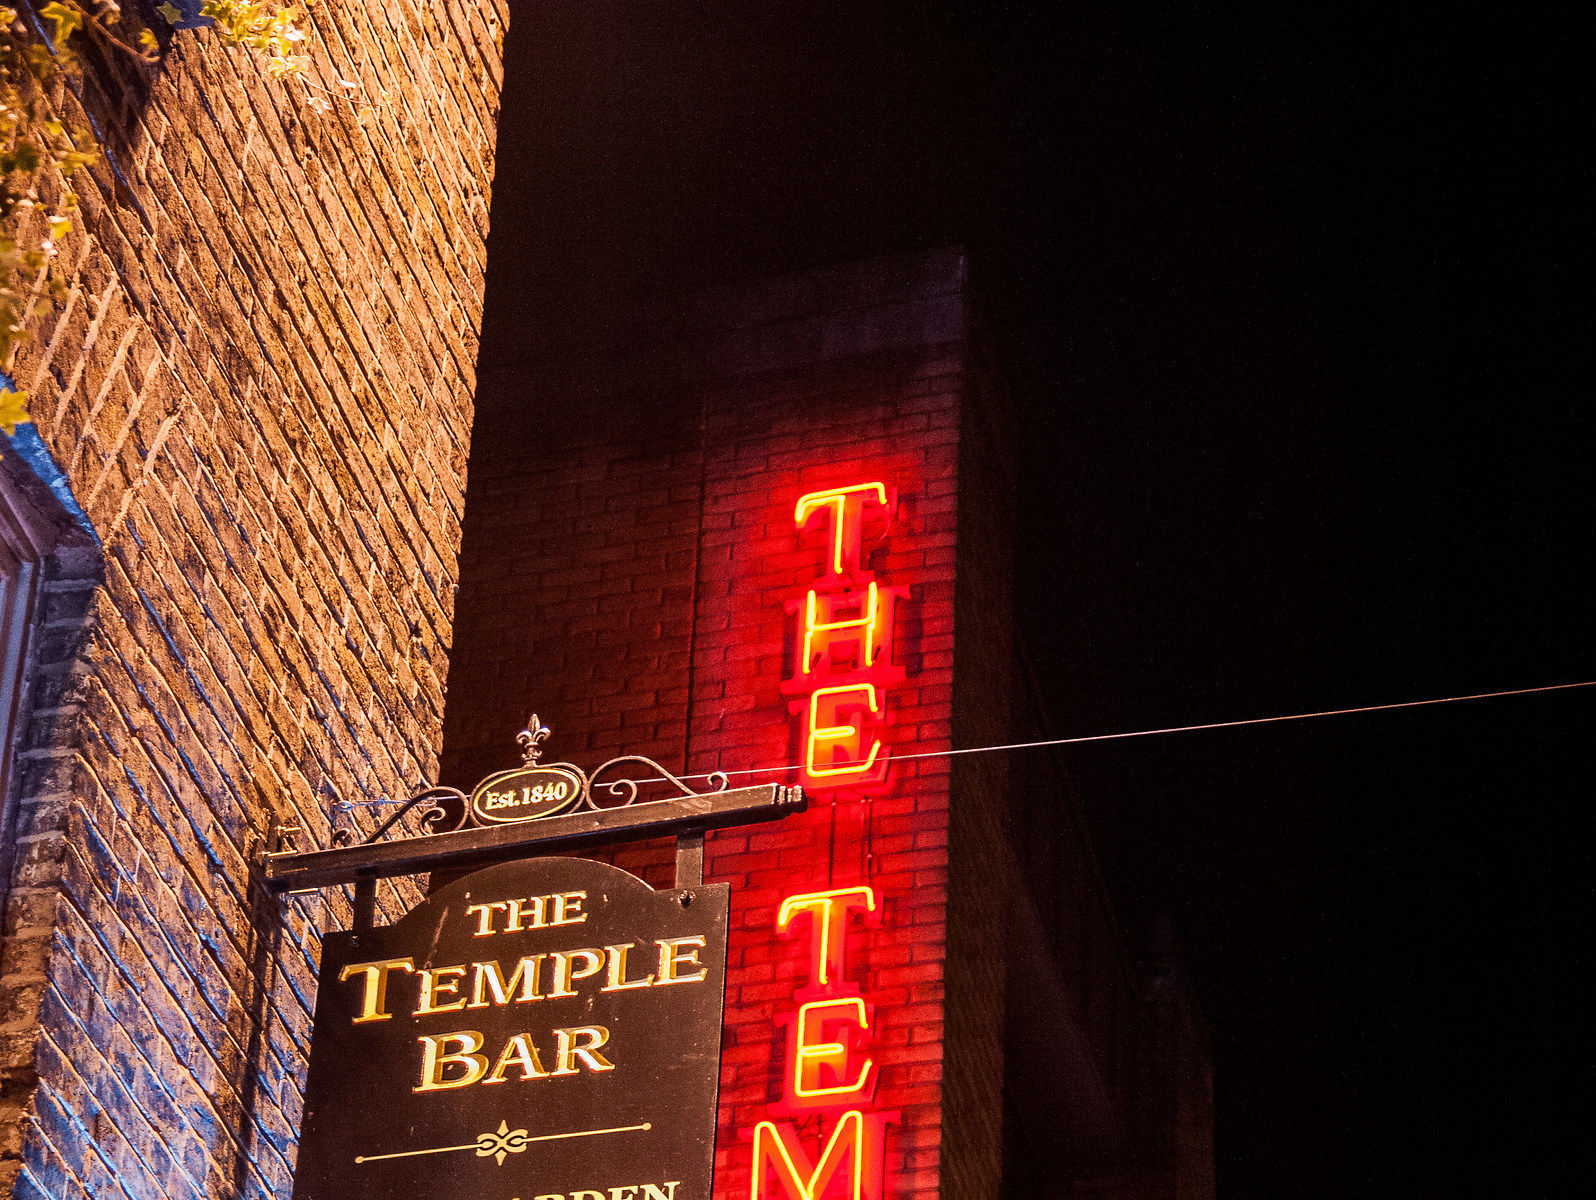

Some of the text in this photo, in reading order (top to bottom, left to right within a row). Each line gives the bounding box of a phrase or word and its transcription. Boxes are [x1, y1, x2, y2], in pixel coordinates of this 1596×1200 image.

[790, 480, 897, 785] THE
[467, 890, 589, 938] THE
[338, 935, 709, 1025] TEMPLE
[412, 1025, 616, 1094] BAR
